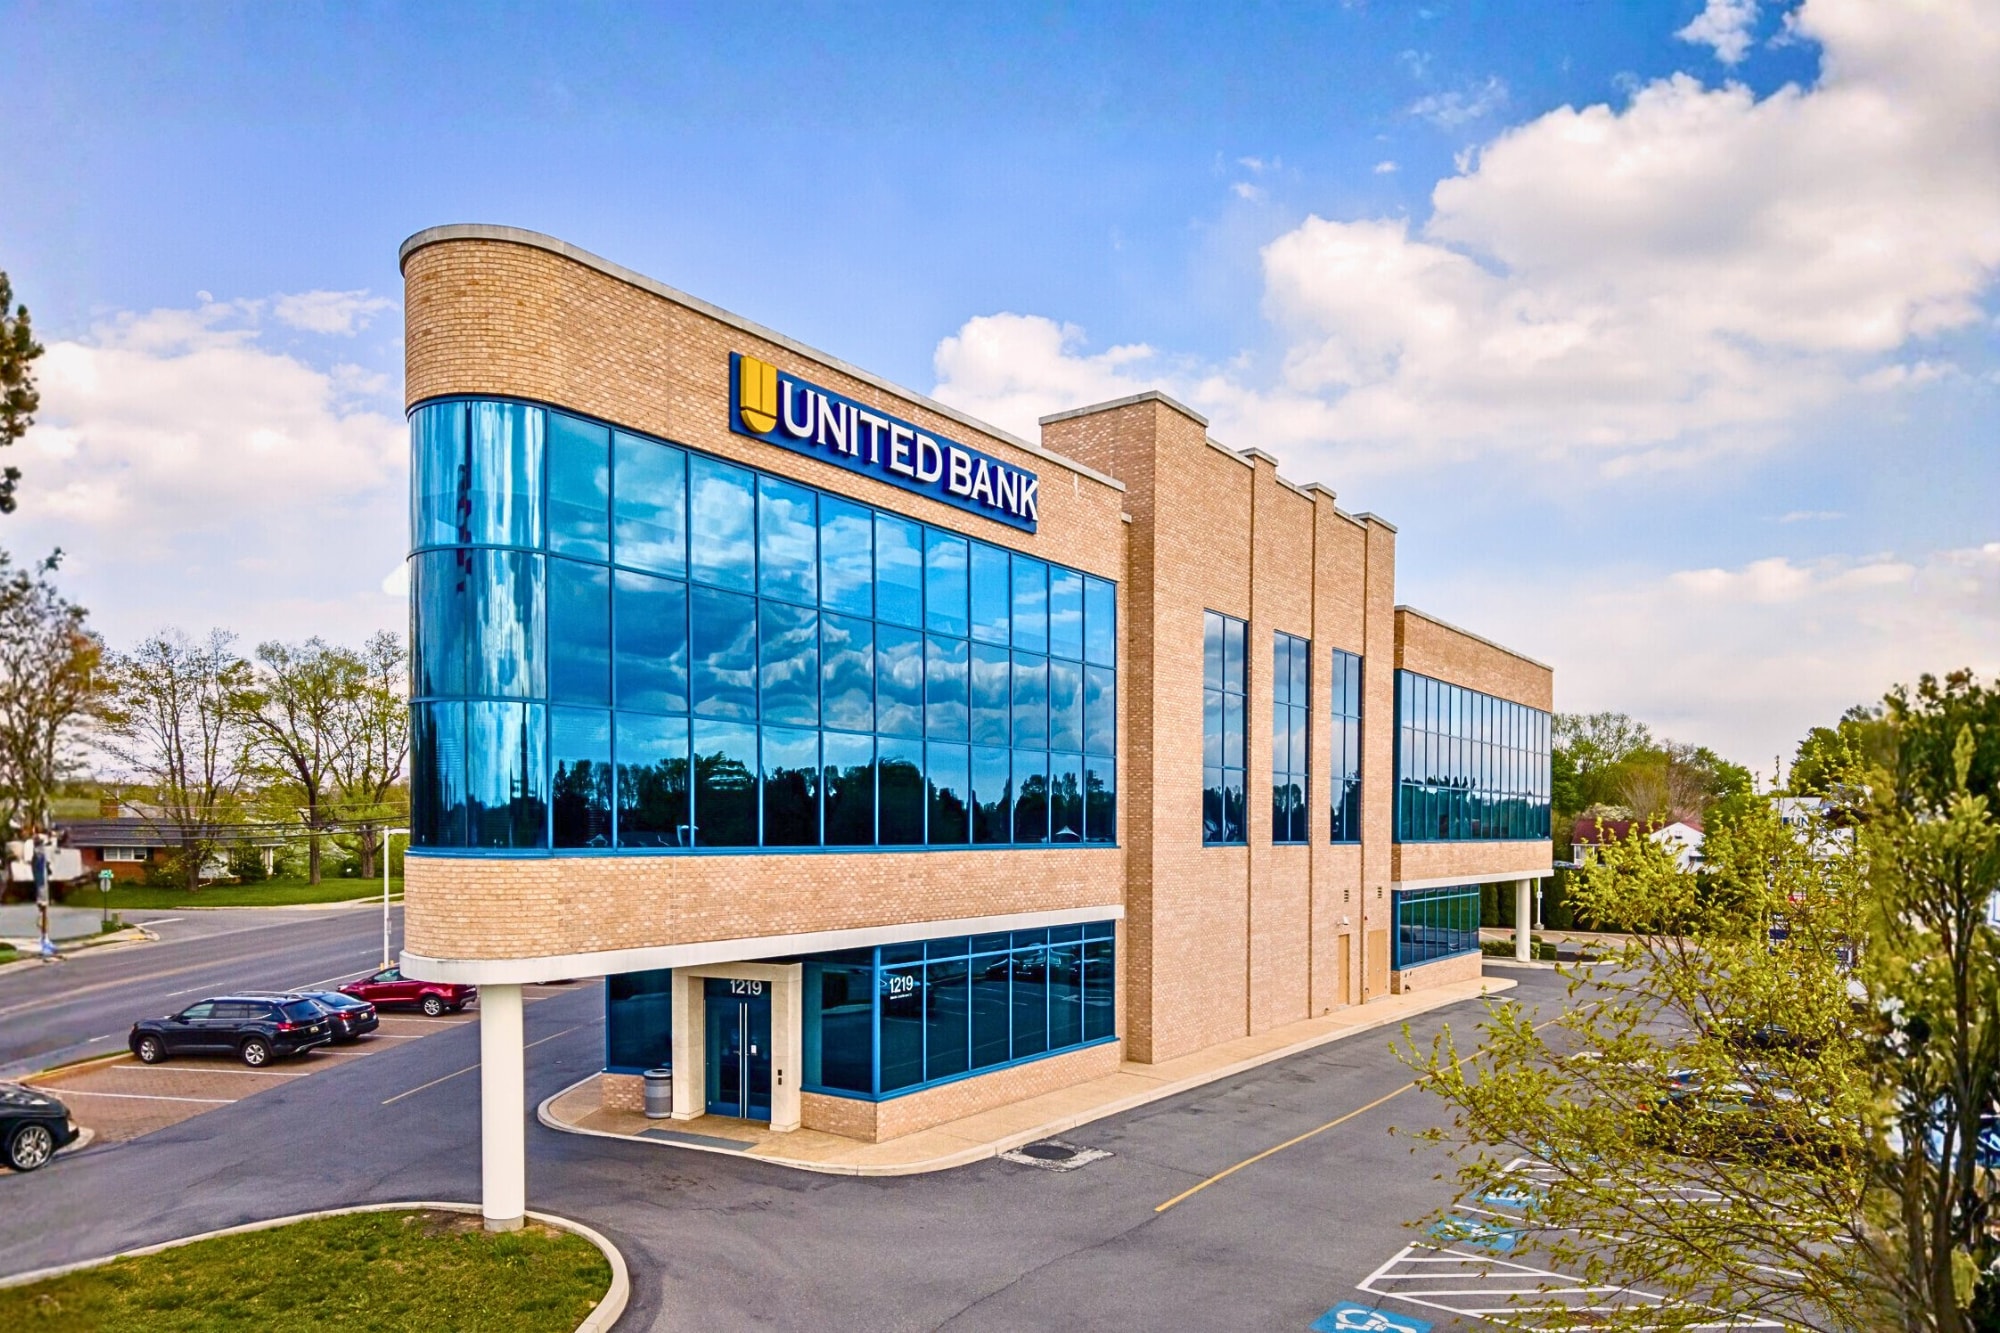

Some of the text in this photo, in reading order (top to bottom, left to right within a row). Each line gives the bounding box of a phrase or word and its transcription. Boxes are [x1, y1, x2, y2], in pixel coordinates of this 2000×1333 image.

[782, 380, 1039, 521] UNITED BANK
[730, 979, 762, 995] 1219
[890, 975, 914, 993] 1219
